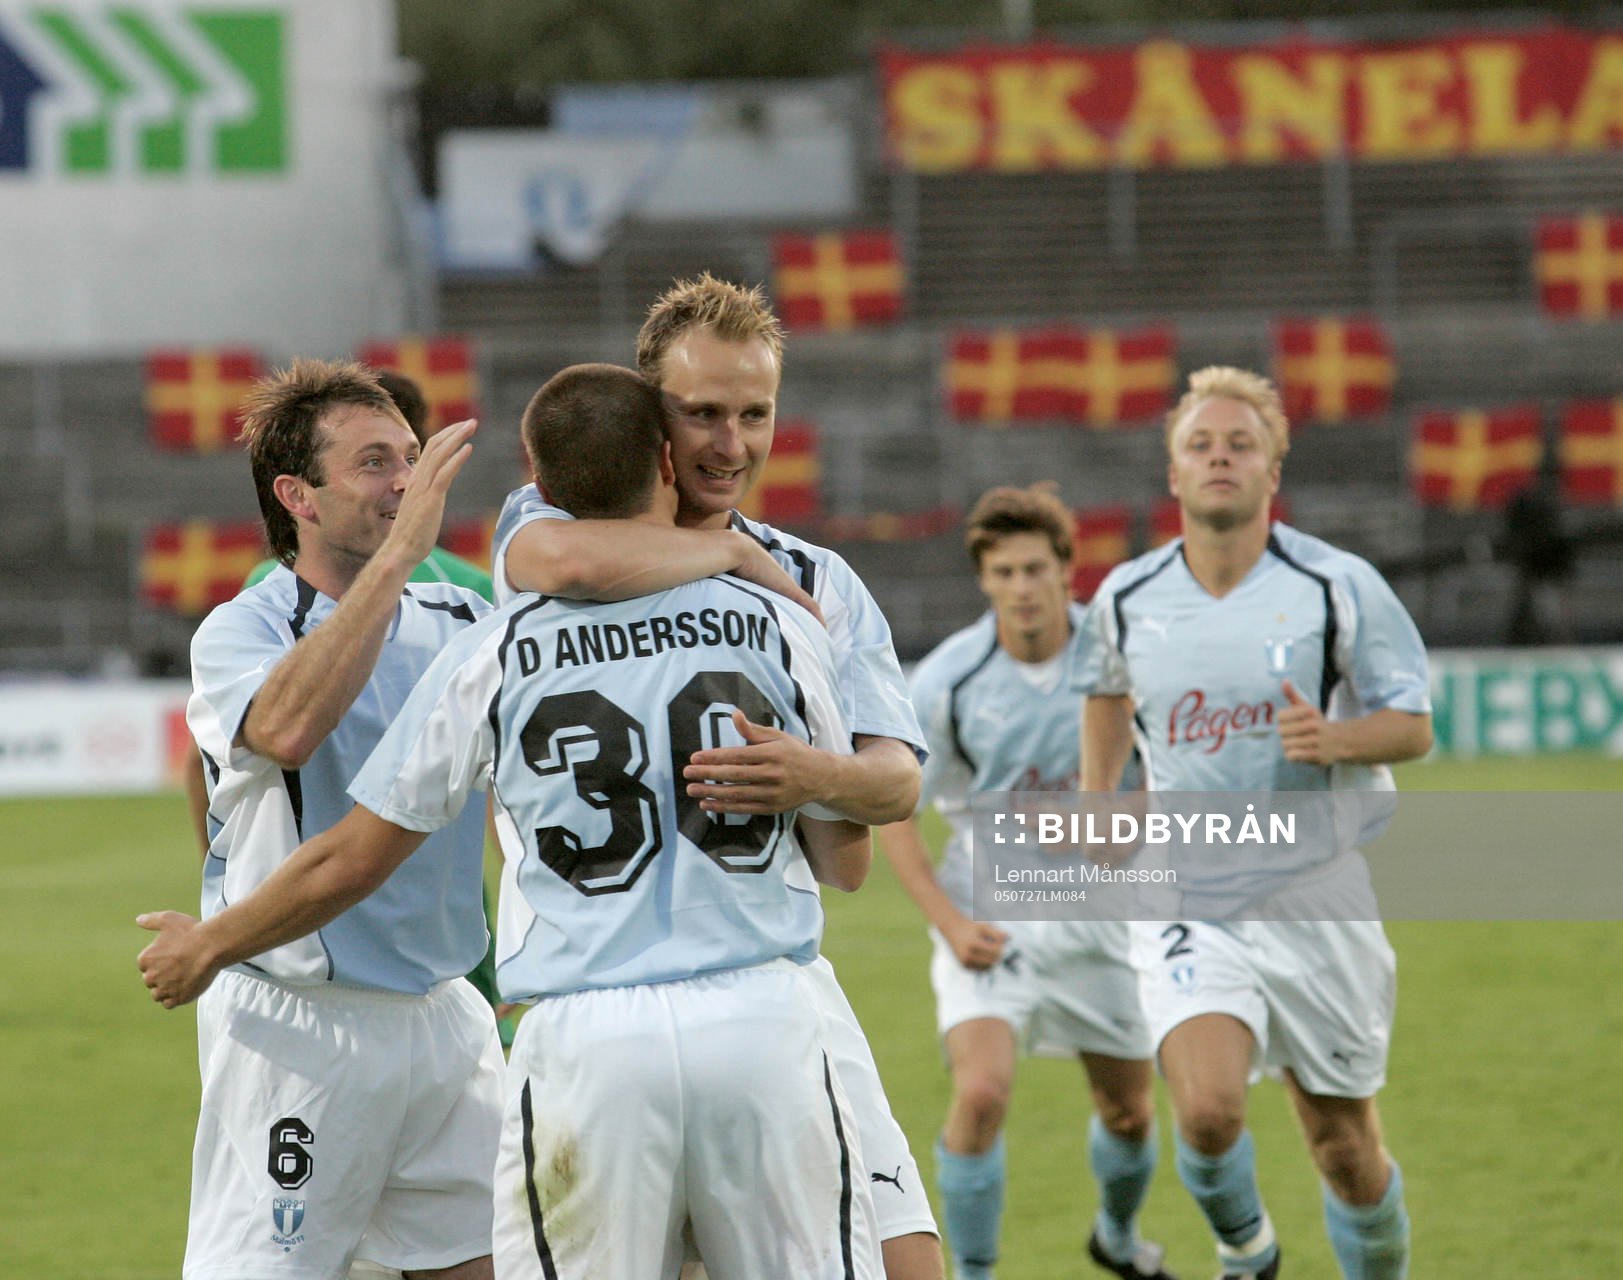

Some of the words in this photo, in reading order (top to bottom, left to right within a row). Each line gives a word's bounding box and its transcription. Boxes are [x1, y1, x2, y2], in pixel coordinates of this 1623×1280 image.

[517, 637, 541, 678] D
[555, 608, 768, 669] ANDERSSON
[520, 671, 785, 896] 30
[1161, 923, 1193, 960] 2
[268, 1118, 314, 1190] 6
